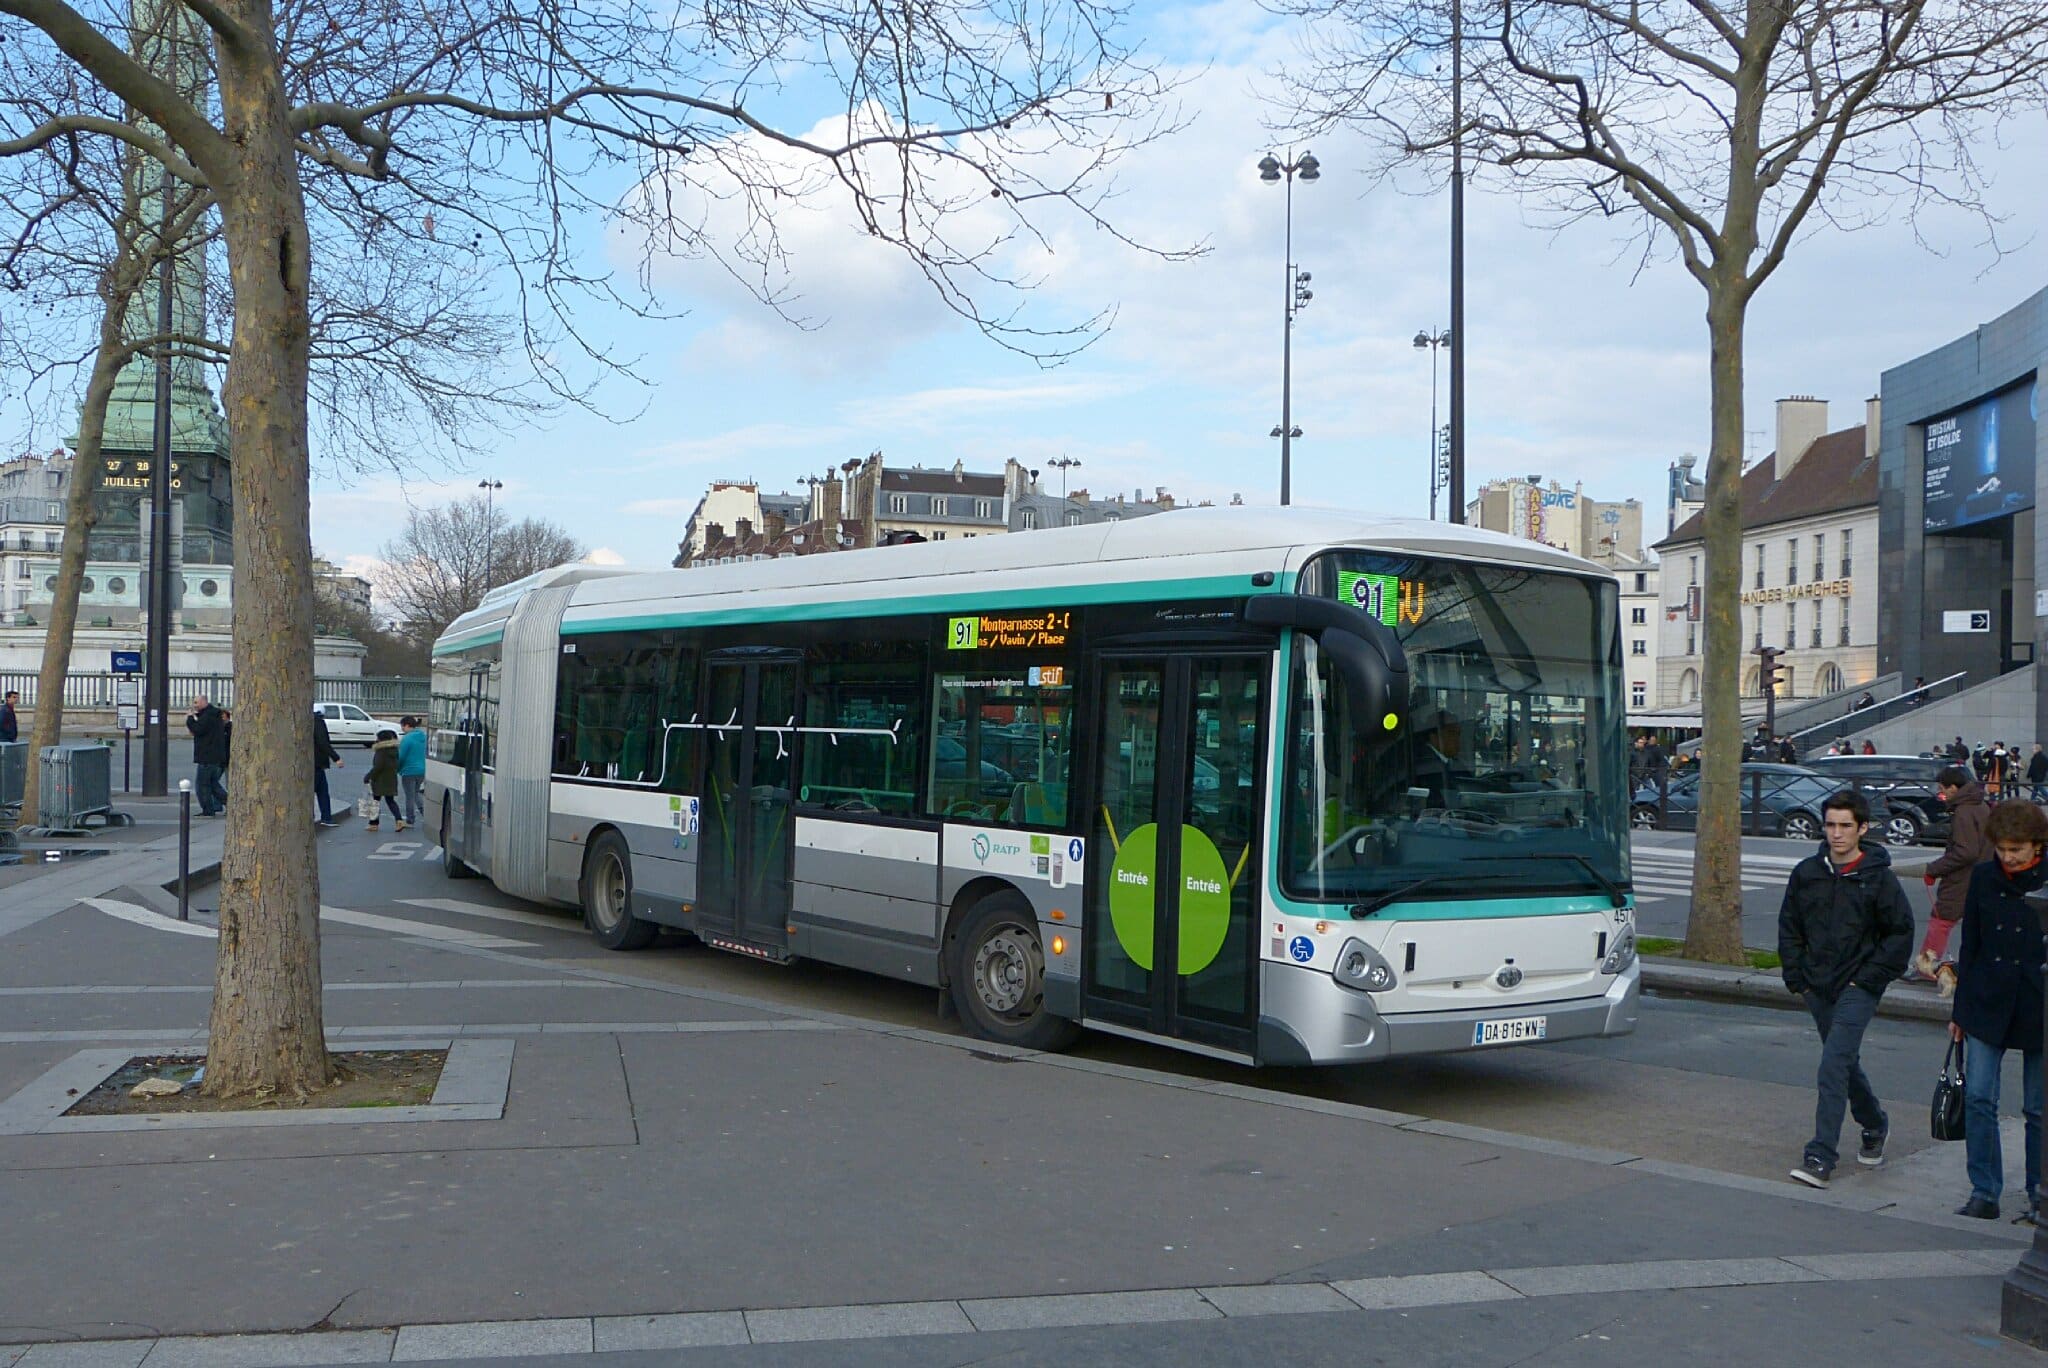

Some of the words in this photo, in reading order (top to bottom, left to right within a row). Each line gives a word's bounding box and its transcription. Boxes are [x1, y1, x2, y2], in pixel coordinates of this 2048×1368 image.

[1928, 417, 1957, 438] TRISTAN
[1928, 438, 1936, 452] ET
[1937, 430, 1962, 449] ISOLDE
[107, 461, 121, 471] 27
[137, 461, 149, 471] 28
[102, 477, 150, 488] JUILLET
[1353, 579, 1383, 621] 91
[980, 616, 1044, 633] Montparnasse
[1046, 613, 1055, 630] 2
[956, 621, 971, 645] 91
[1000, 633, 1025, 646] Vavin
[1038, 631, 1065, 645] Place
[1041, 667, 1064, 686] stif
[992, 844, 1021, 856] RATP
[1117, 869, 1149, 886] Entrée
[1186, 876, 1221, 894] Entrée
